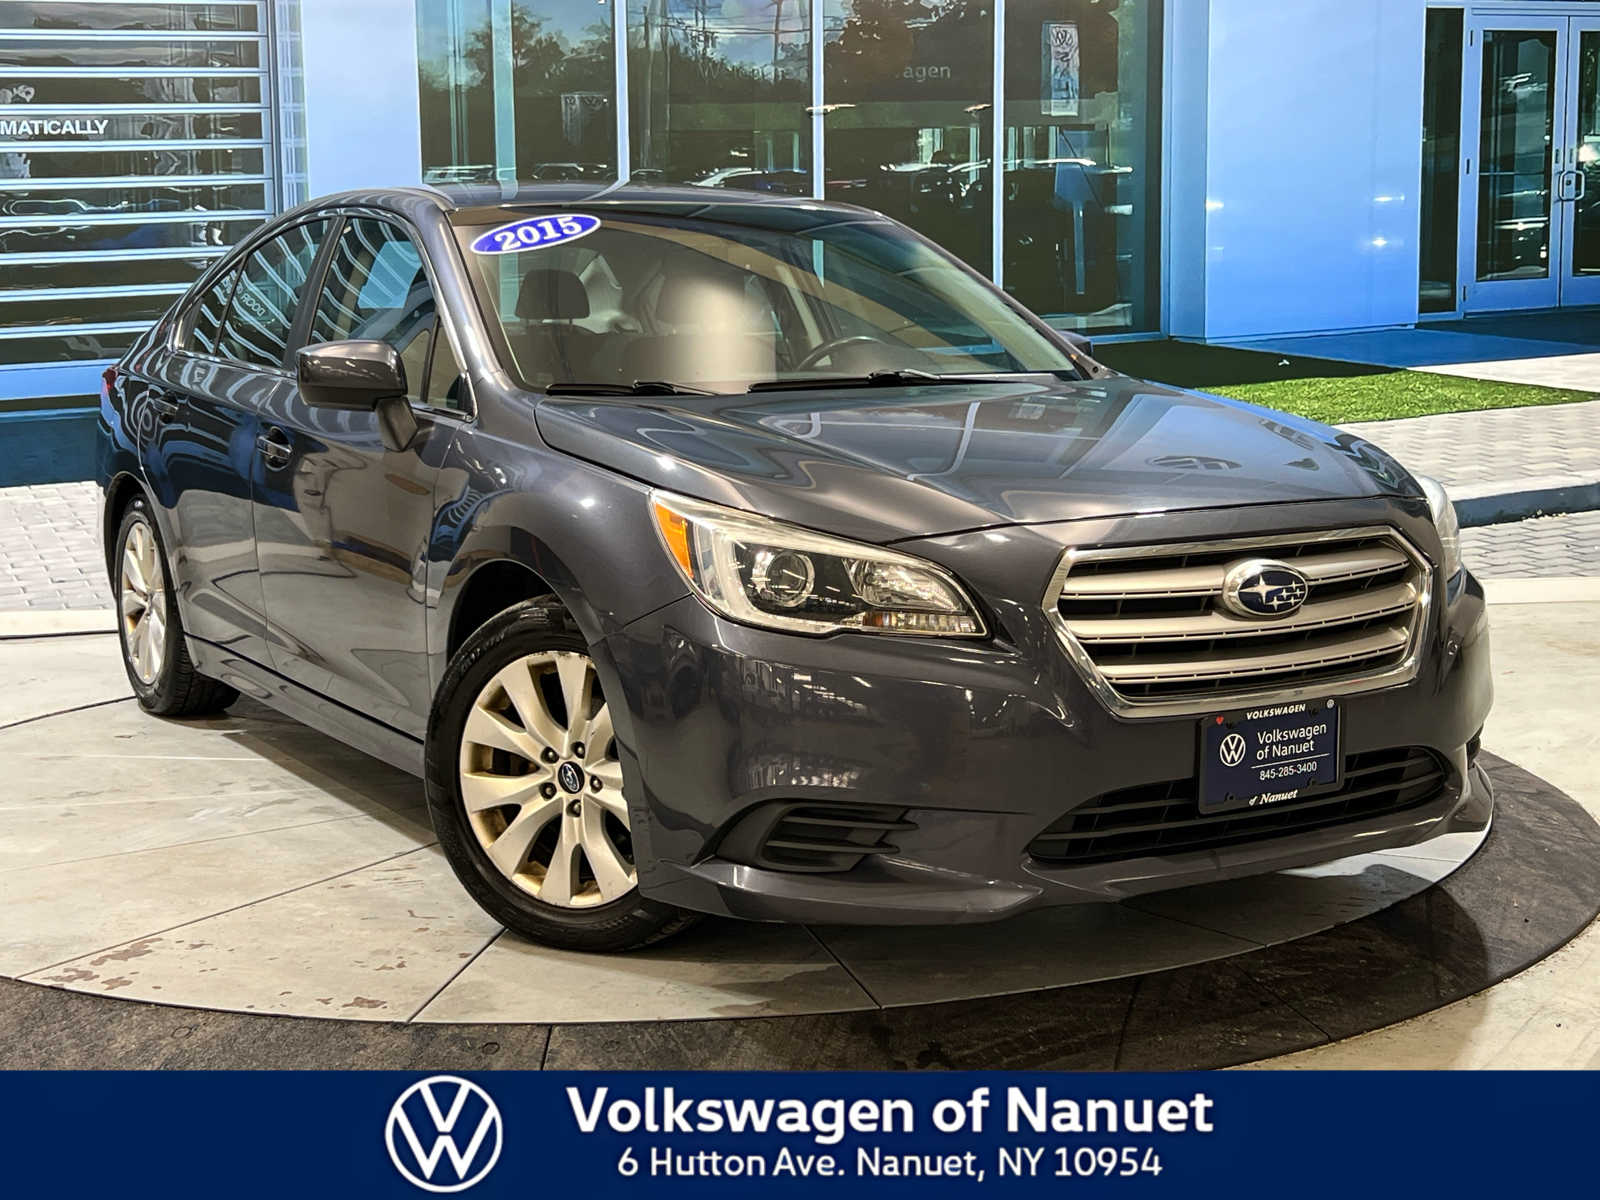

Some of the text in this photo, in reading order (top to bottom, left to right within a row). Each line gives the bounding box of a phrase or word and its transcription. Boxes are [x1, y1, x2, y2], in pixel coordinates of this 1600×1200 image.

[0, 119, 109, 135] MATICALLY
[494, 216, 582, 250] 2015
[1246, 704, 1306, 720] VOLKSWAGEN
[1257, 724, 1327, 745] Volkswagen
[1256, 740, 1315, 760] of Nanuet
[1259, 761, 1318, 781] 845-285-3400
[1259, 789, 1298, 805] Nanuet
